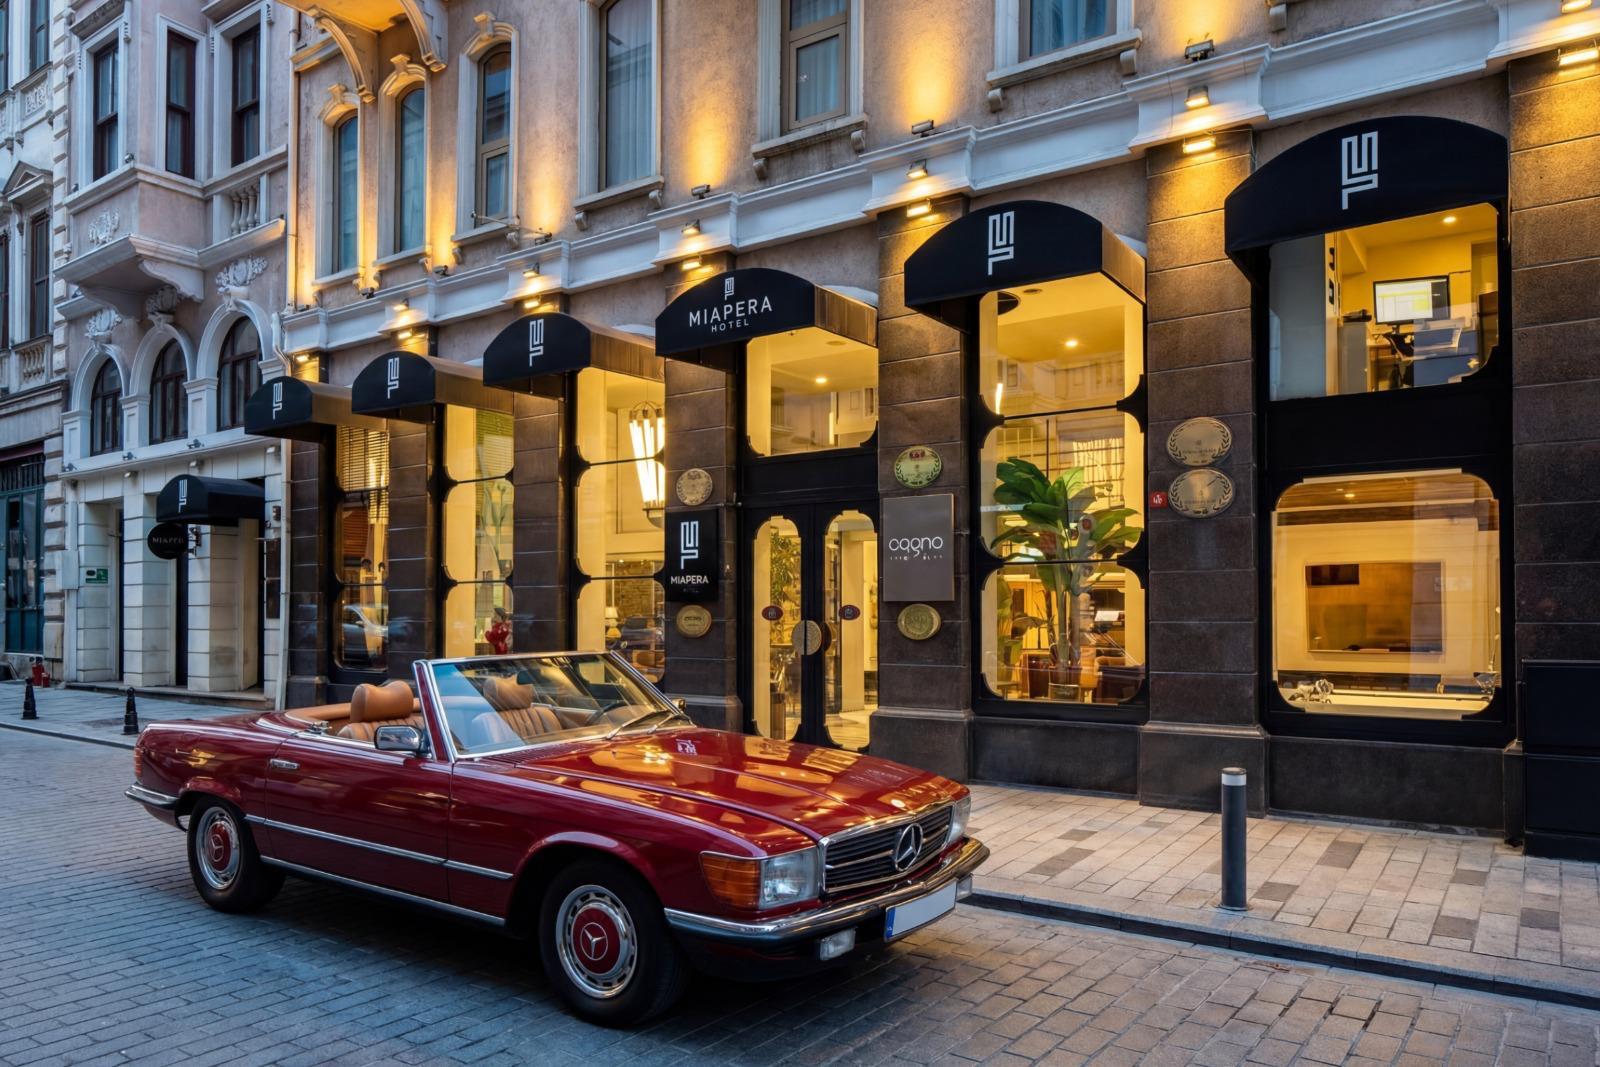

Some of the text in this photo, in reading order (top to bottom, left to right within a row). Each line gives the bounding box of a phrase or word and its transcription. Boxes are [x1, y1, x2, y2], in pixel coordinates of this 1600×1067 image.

[689, 295, 773, 327] MIAPERA
[711, 318, 750, 333] HOTEL
[670, 574, 709, 585] MIAPERA
